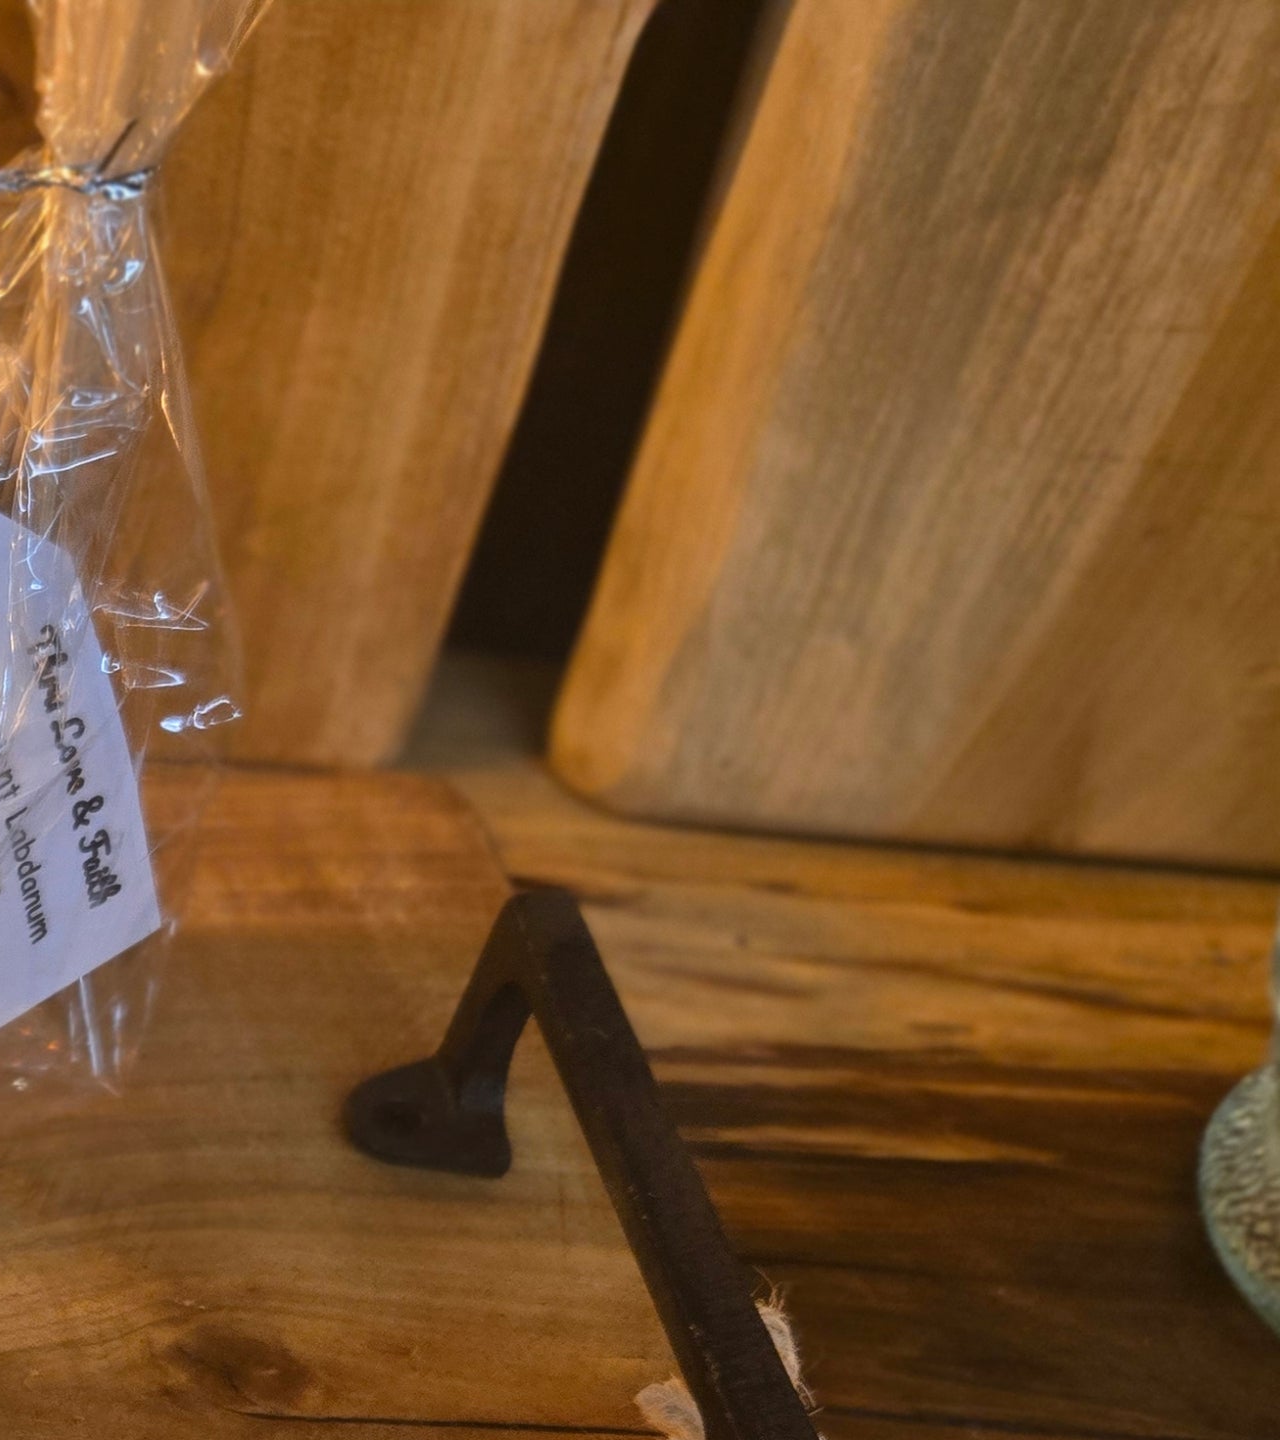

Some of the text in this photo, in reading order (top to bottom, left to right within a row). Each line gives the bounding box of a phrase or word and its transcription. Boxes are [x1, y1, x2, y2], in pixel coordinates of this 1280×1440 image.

[50, 717, 85, 796] Love
[72, 795, 104, 831] &
[4, 806, 48, 946] Labdanum
[78, 829, 122, 910] Faith
